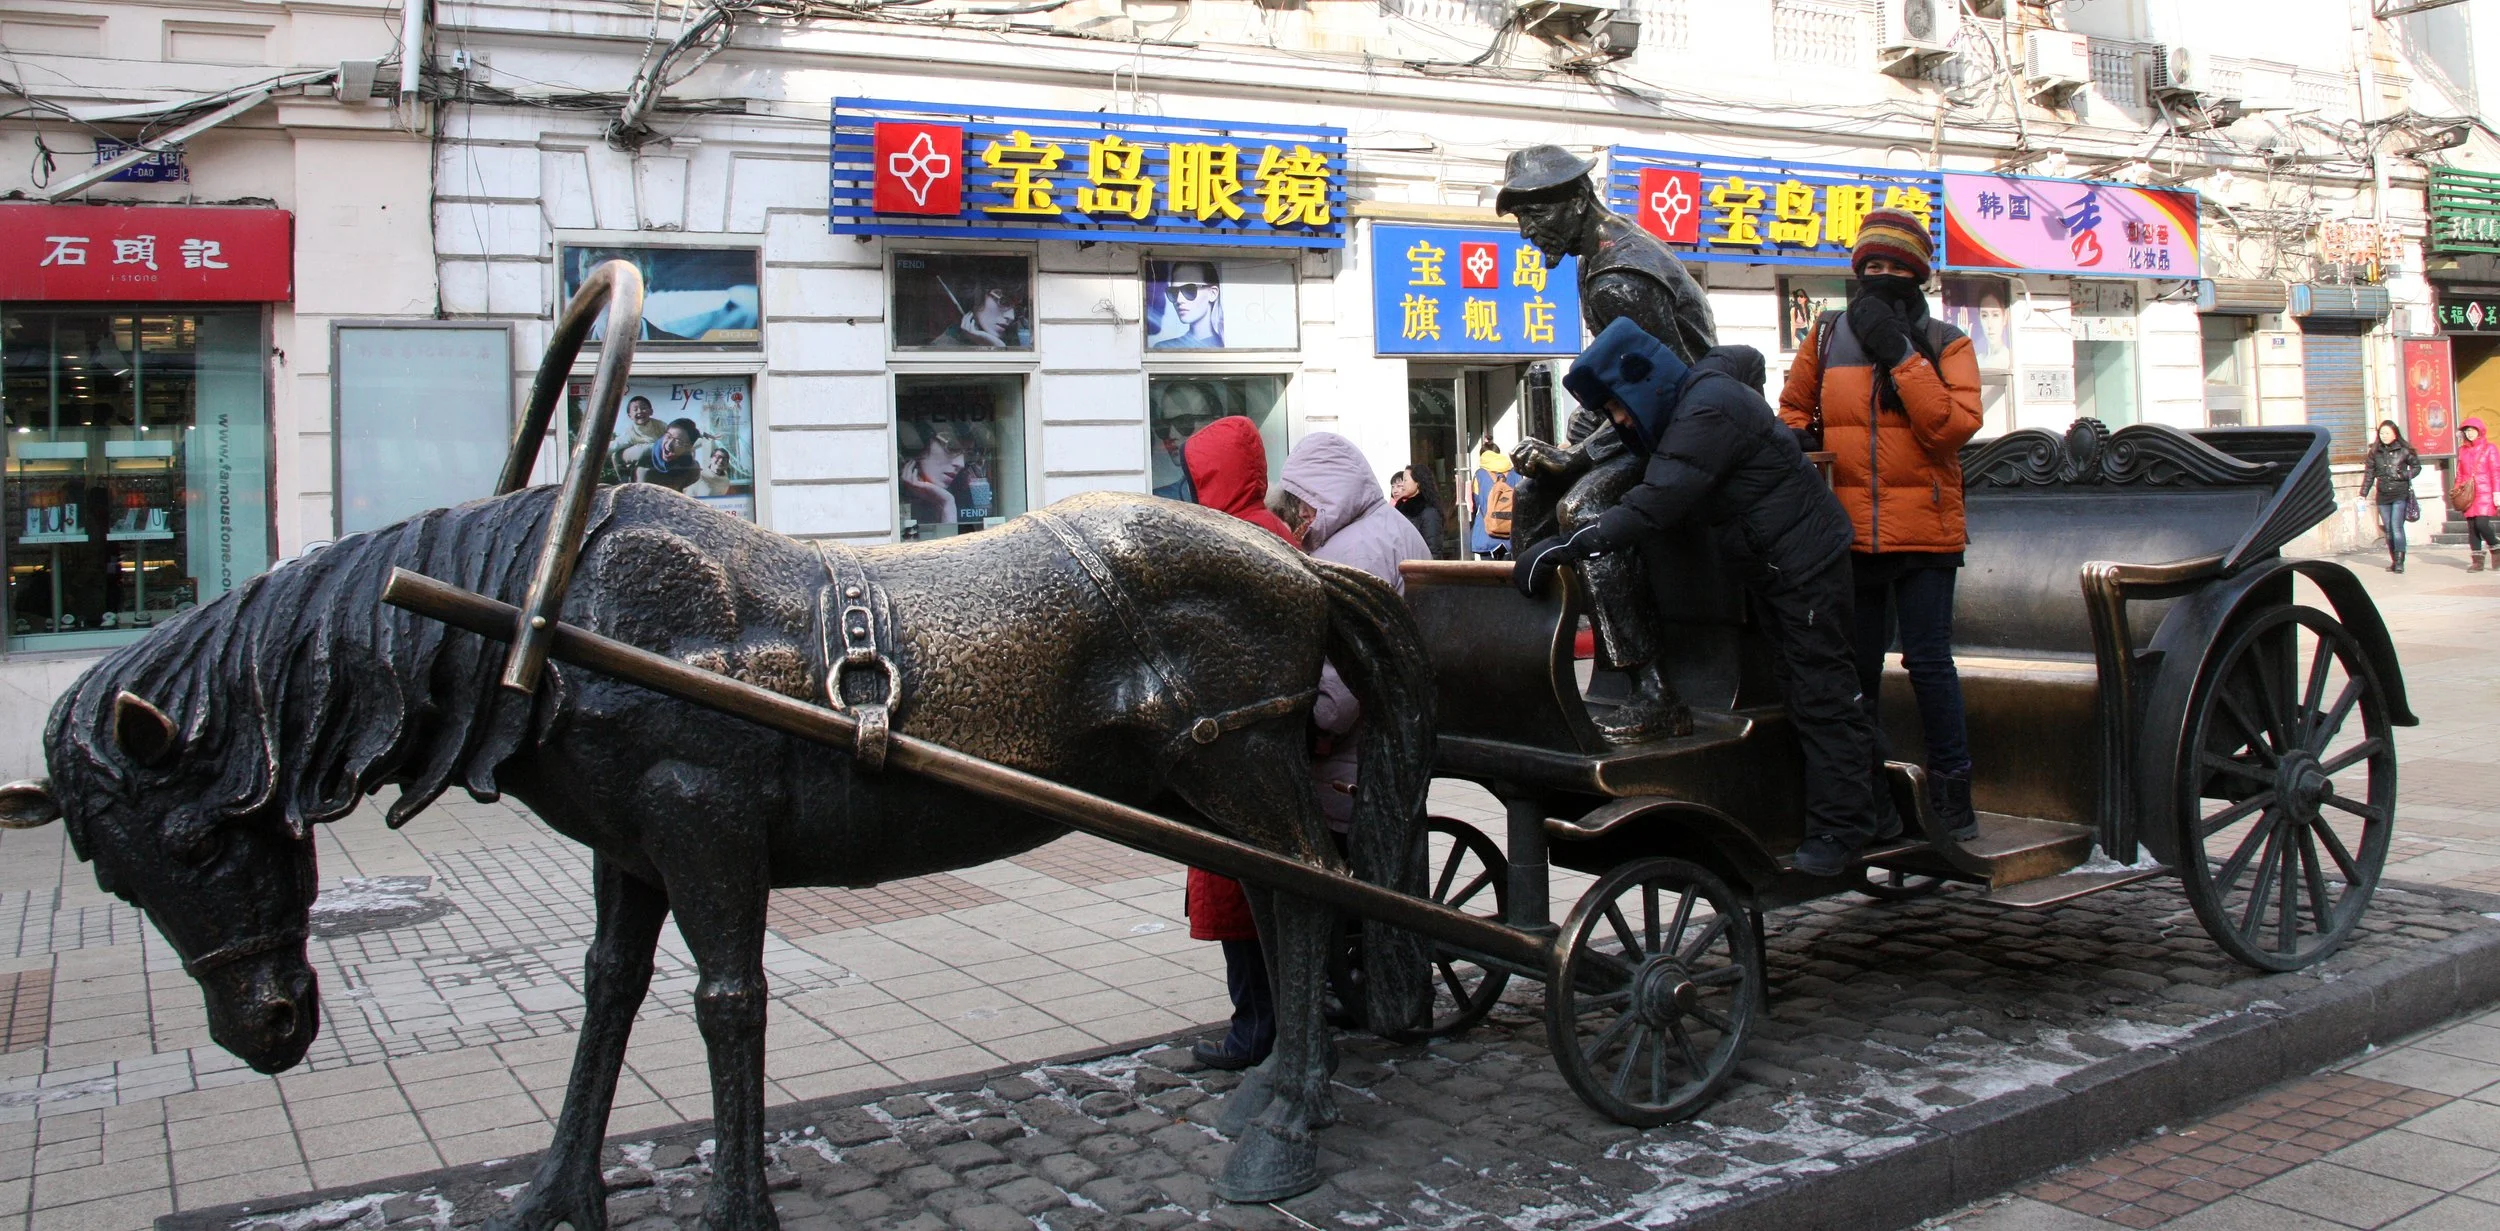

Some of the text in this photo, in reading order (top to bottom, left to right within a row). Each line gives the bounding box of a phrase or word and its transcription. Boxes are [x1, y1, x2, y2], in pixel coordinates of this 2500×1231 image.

[98, 144, 181, 166] 西道街
[165, 169, 178, 177] JIE
[981, 130, 1330, 225] 宝岛眼镜
[1977, 191, 2030, 220] 韩国
[2057, 190, 2103, 266] 秀
[40, 235, 229, 271] 石頭記
[897, 260, 925, 269] FENDI
[1407, 240, 1547, 292] 宝 岛
[2128, 247, 2169, 270] 化妆品
[1400, 293, 1556, 343] 旗舰店
[671, 384, 704, 410] Eye
[218, 413, 232, 592] www.famoustone.co
[960, 508, 988, 517] FENDI
